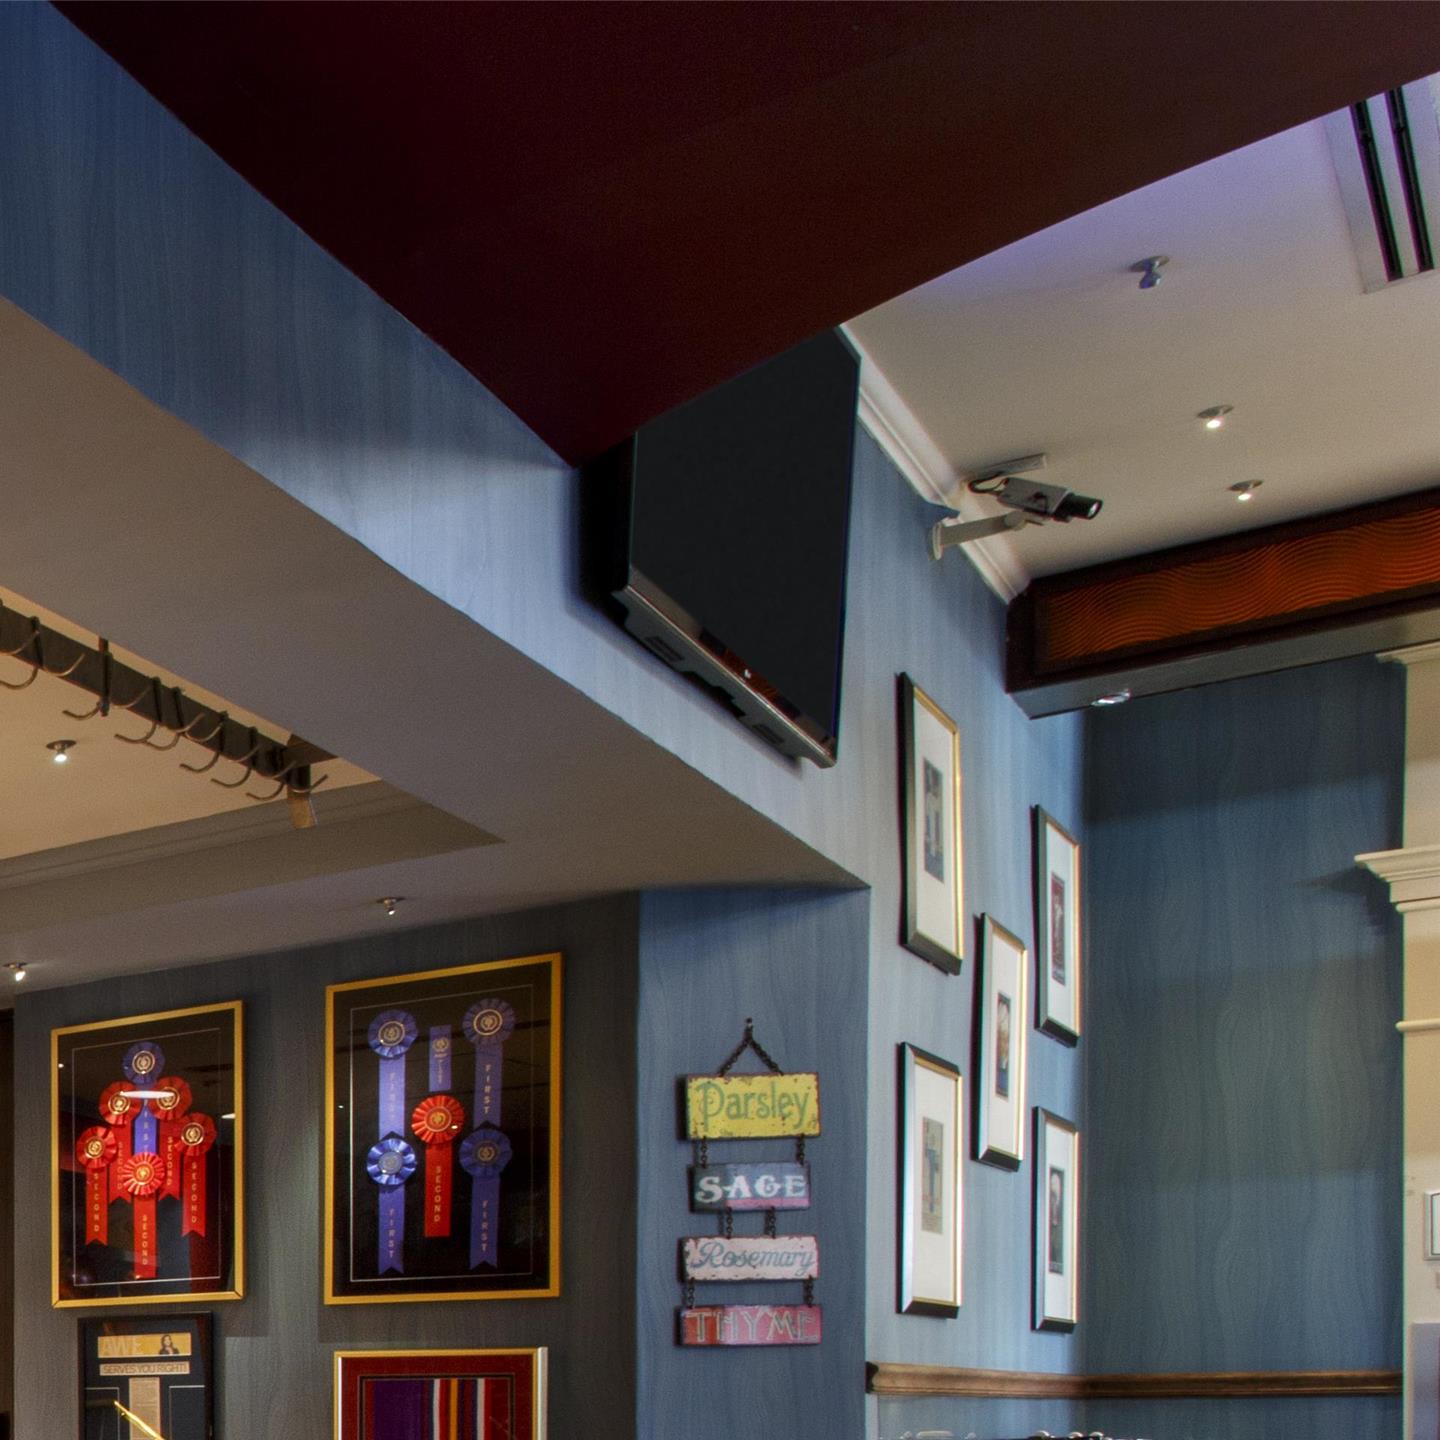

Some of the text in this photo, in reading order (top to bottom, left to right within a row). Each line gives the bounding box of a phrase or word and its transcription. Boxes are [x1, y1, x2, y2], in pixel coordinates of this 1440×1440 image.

[482, 1064, 491, 1115] FIRST
[695, 1081, 810, 1132] Parsley
[433, 1166, 441, 1223] SECOND
[695, 1174, 807, 1203] SAGE
[141, 1215, 149, 1265] SECOND
[691, 1241, 815, 1277] Rosemary
[685, 1309, 819, 1343] THYME
